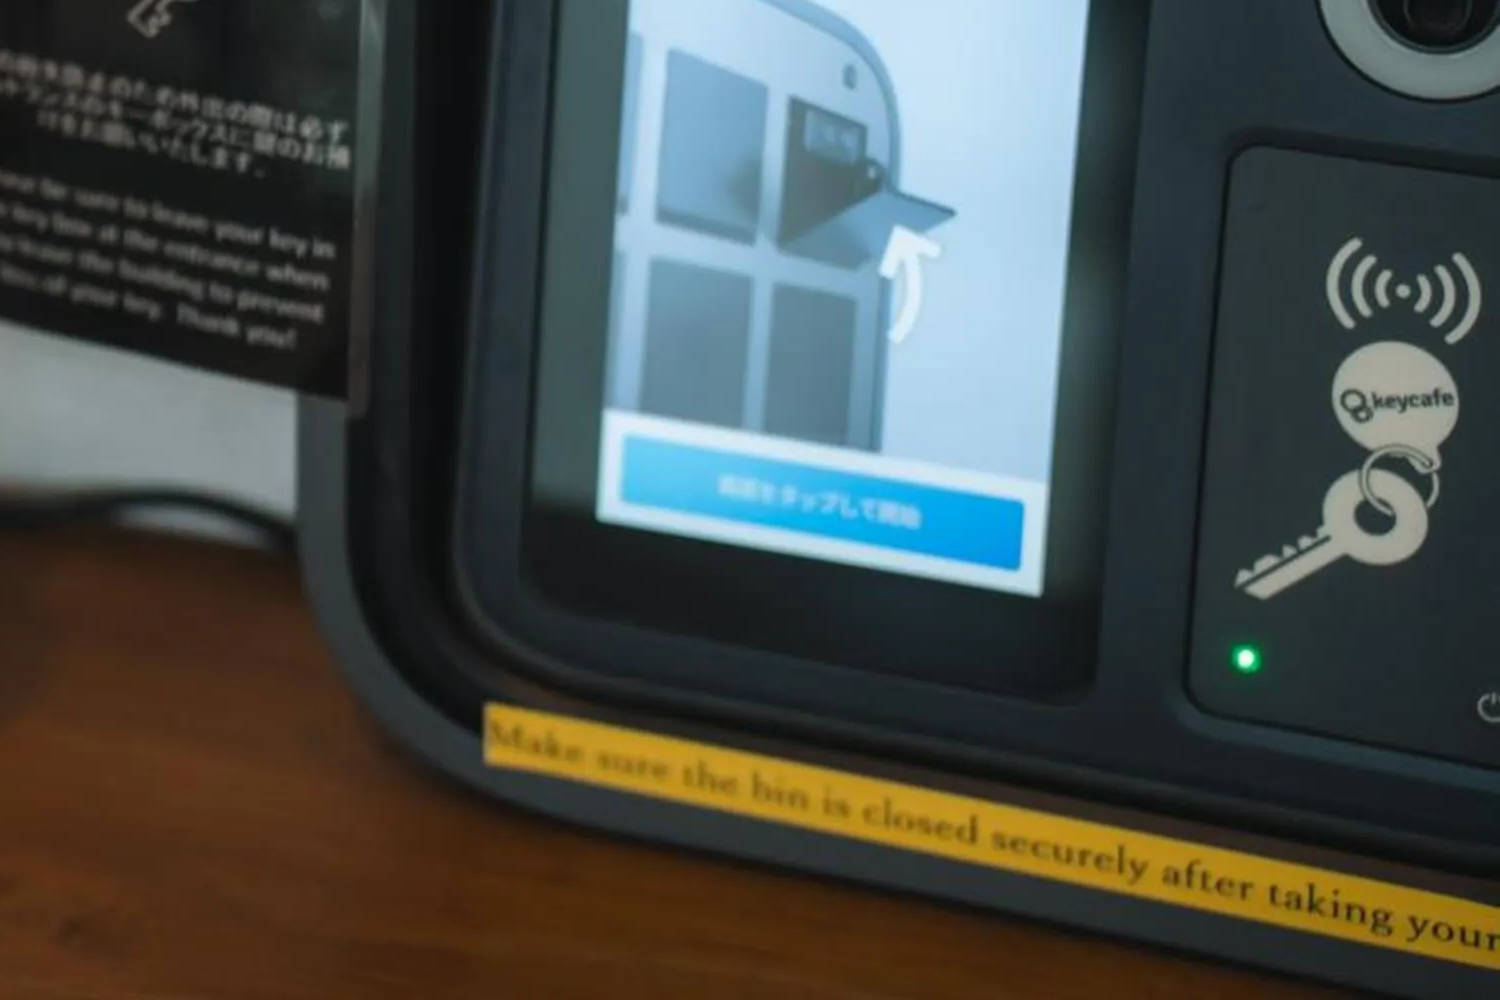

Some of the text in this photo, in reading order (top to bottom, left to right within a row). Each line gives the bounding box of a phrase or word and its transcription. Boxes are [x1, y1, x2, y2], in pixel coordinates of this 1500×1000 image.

[269, 227, 307, 259] key
[1371, 387, 1455, 414] keycafe
[490, 720, 1500, 952] Make sure the bin is closed securely after taking your
